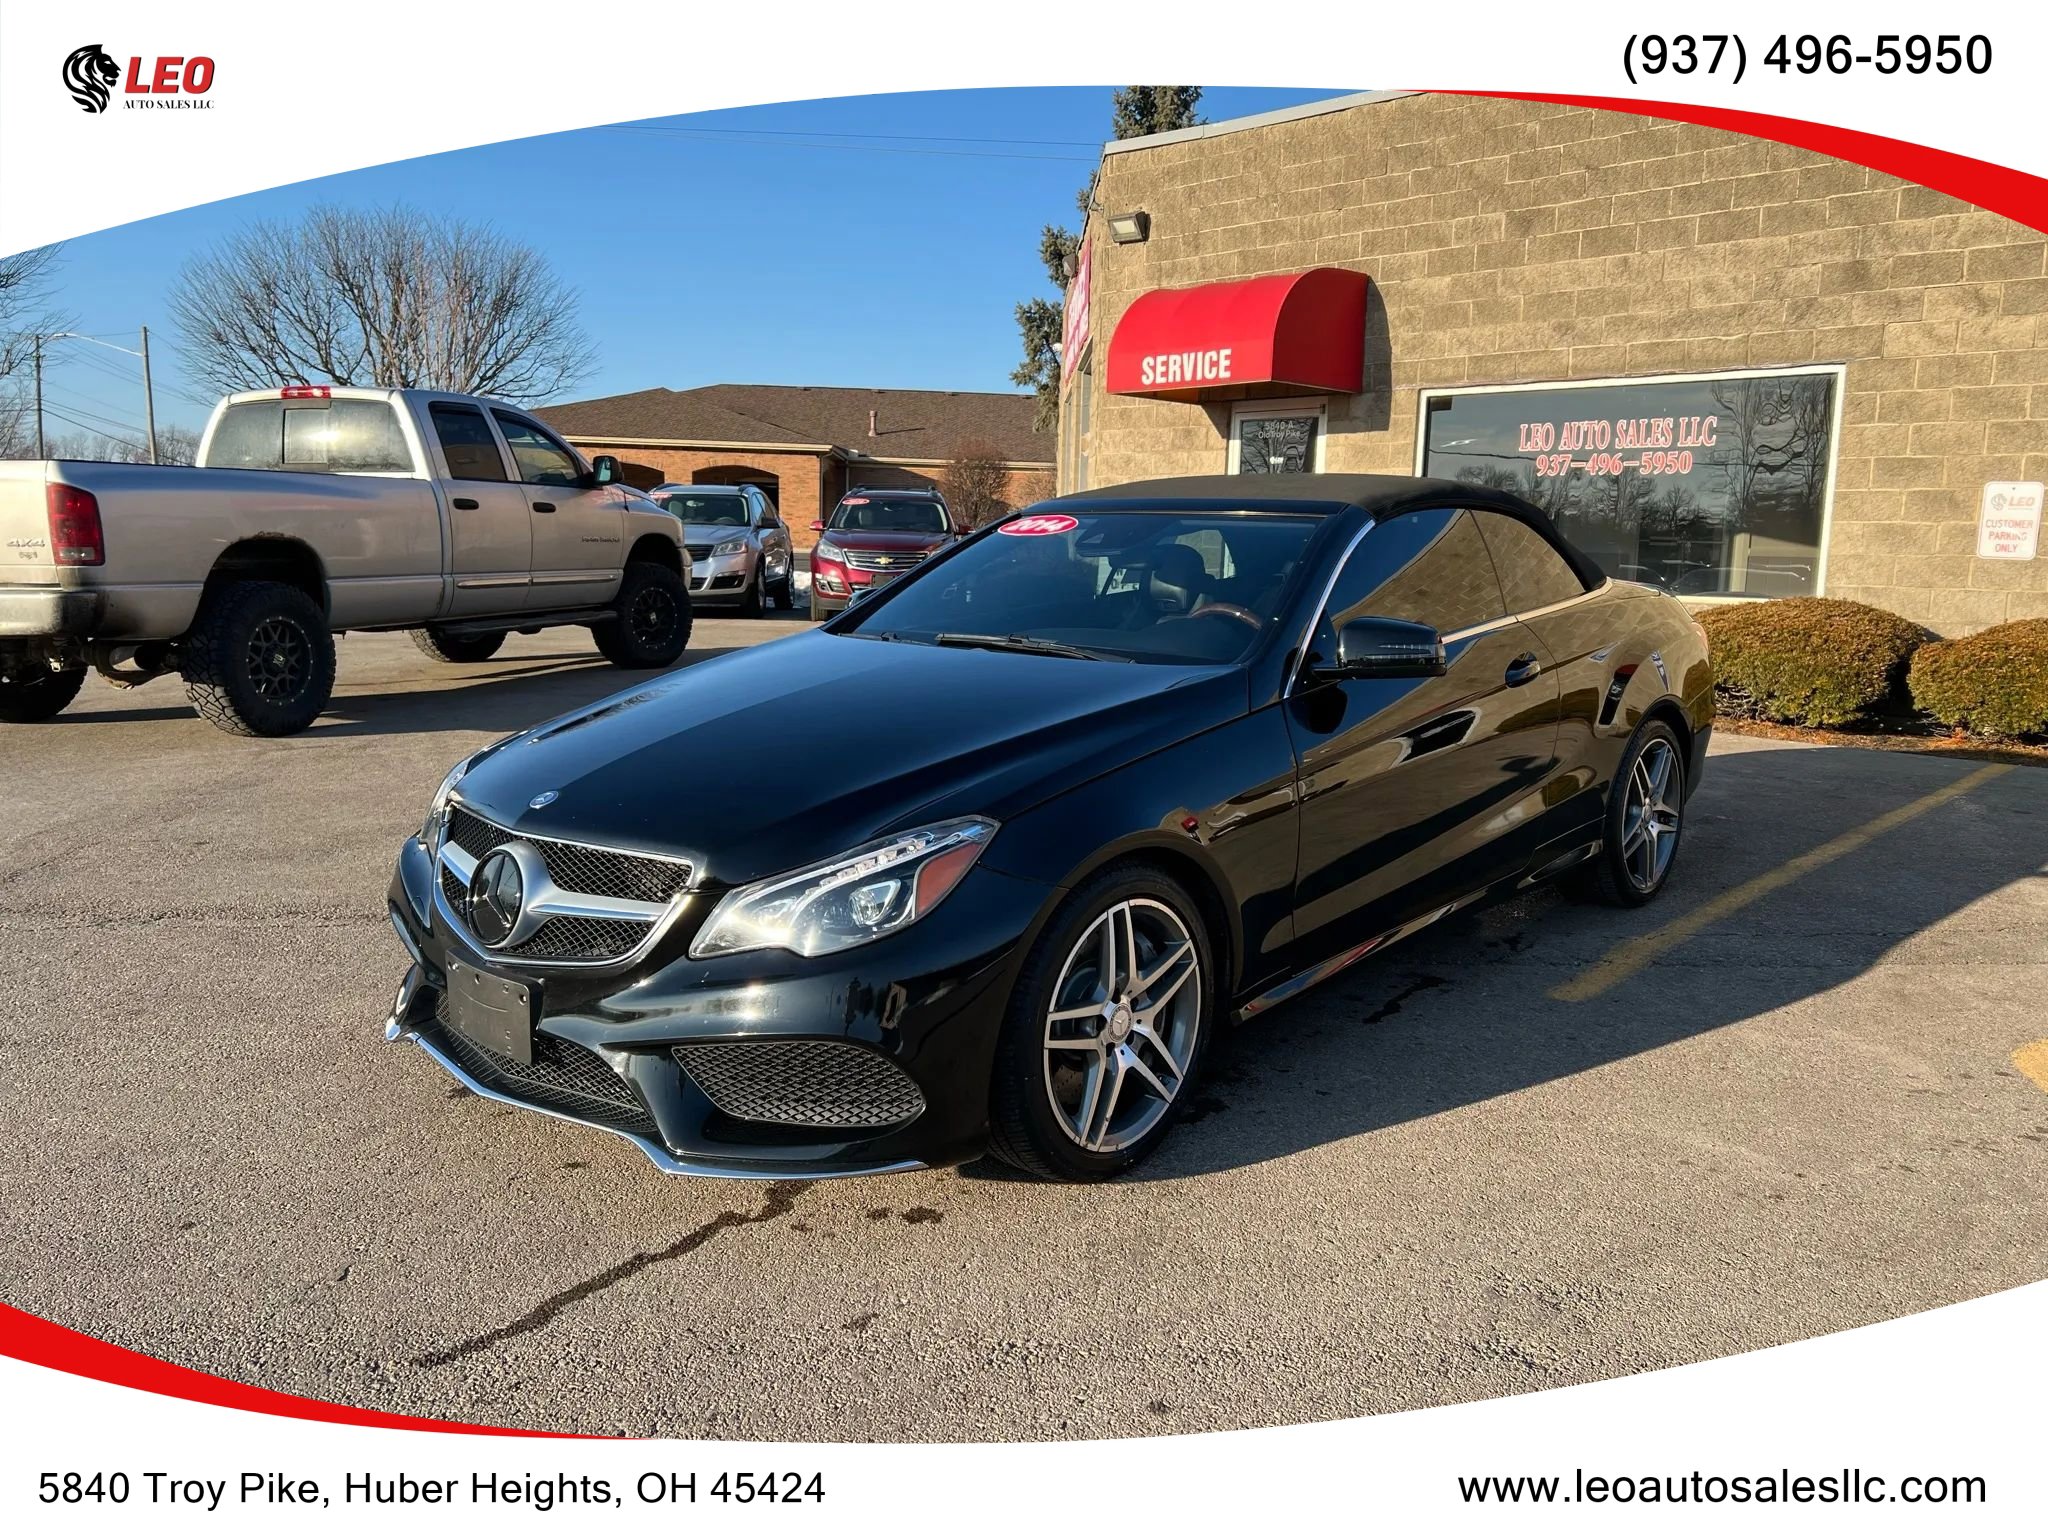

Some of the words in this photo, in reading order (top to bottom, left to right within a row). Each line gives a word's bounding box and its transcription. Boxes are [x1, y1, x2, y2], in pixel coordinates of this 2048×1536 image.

[1141, 348, 1232, 386] SERVICE
[1519, 423, 1554, 451] LEO
[1558, 420, 1611, 450] AUTO
[1615, 417, 1673, 448] SALES
[1677, 416, 1717, 447] LLC
[1535, 450, 1693, 477] 937-496-5950
[1985, 519, 2034, 529] CUSTOMER
[1988, 531, 2028, 541] PARKING
[1994, 543, 2018, 553] ONLY
